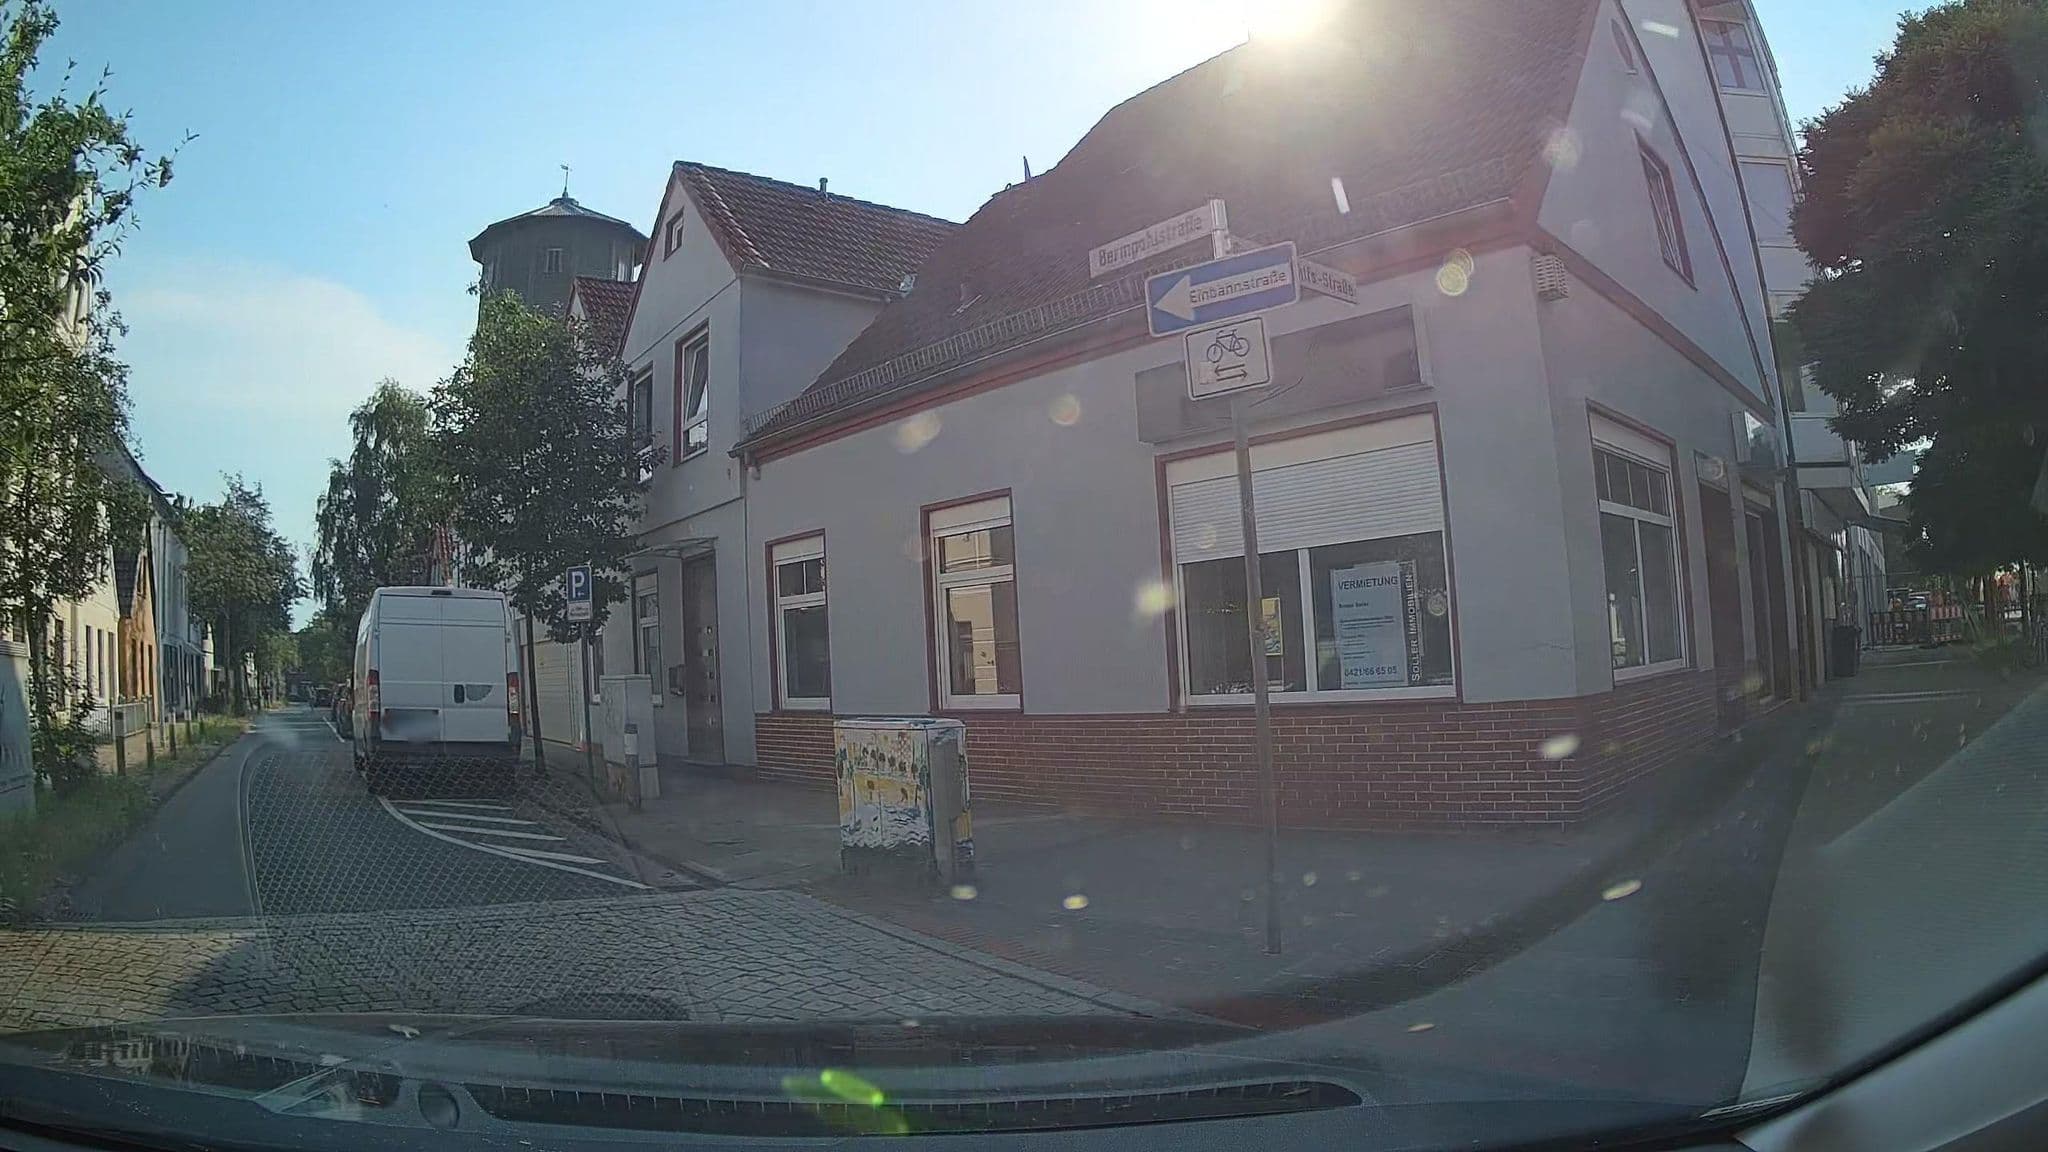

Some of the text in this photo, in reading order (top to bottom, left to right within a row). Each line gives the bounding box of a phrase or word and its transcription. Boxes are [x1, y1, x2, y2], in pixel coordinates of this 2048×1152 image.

[572, 571, 585, 599] P
[1338, 576, 1398, 590] VERMIETUNG
[1405, 574, 1418, 635] IMMOBILIEN
